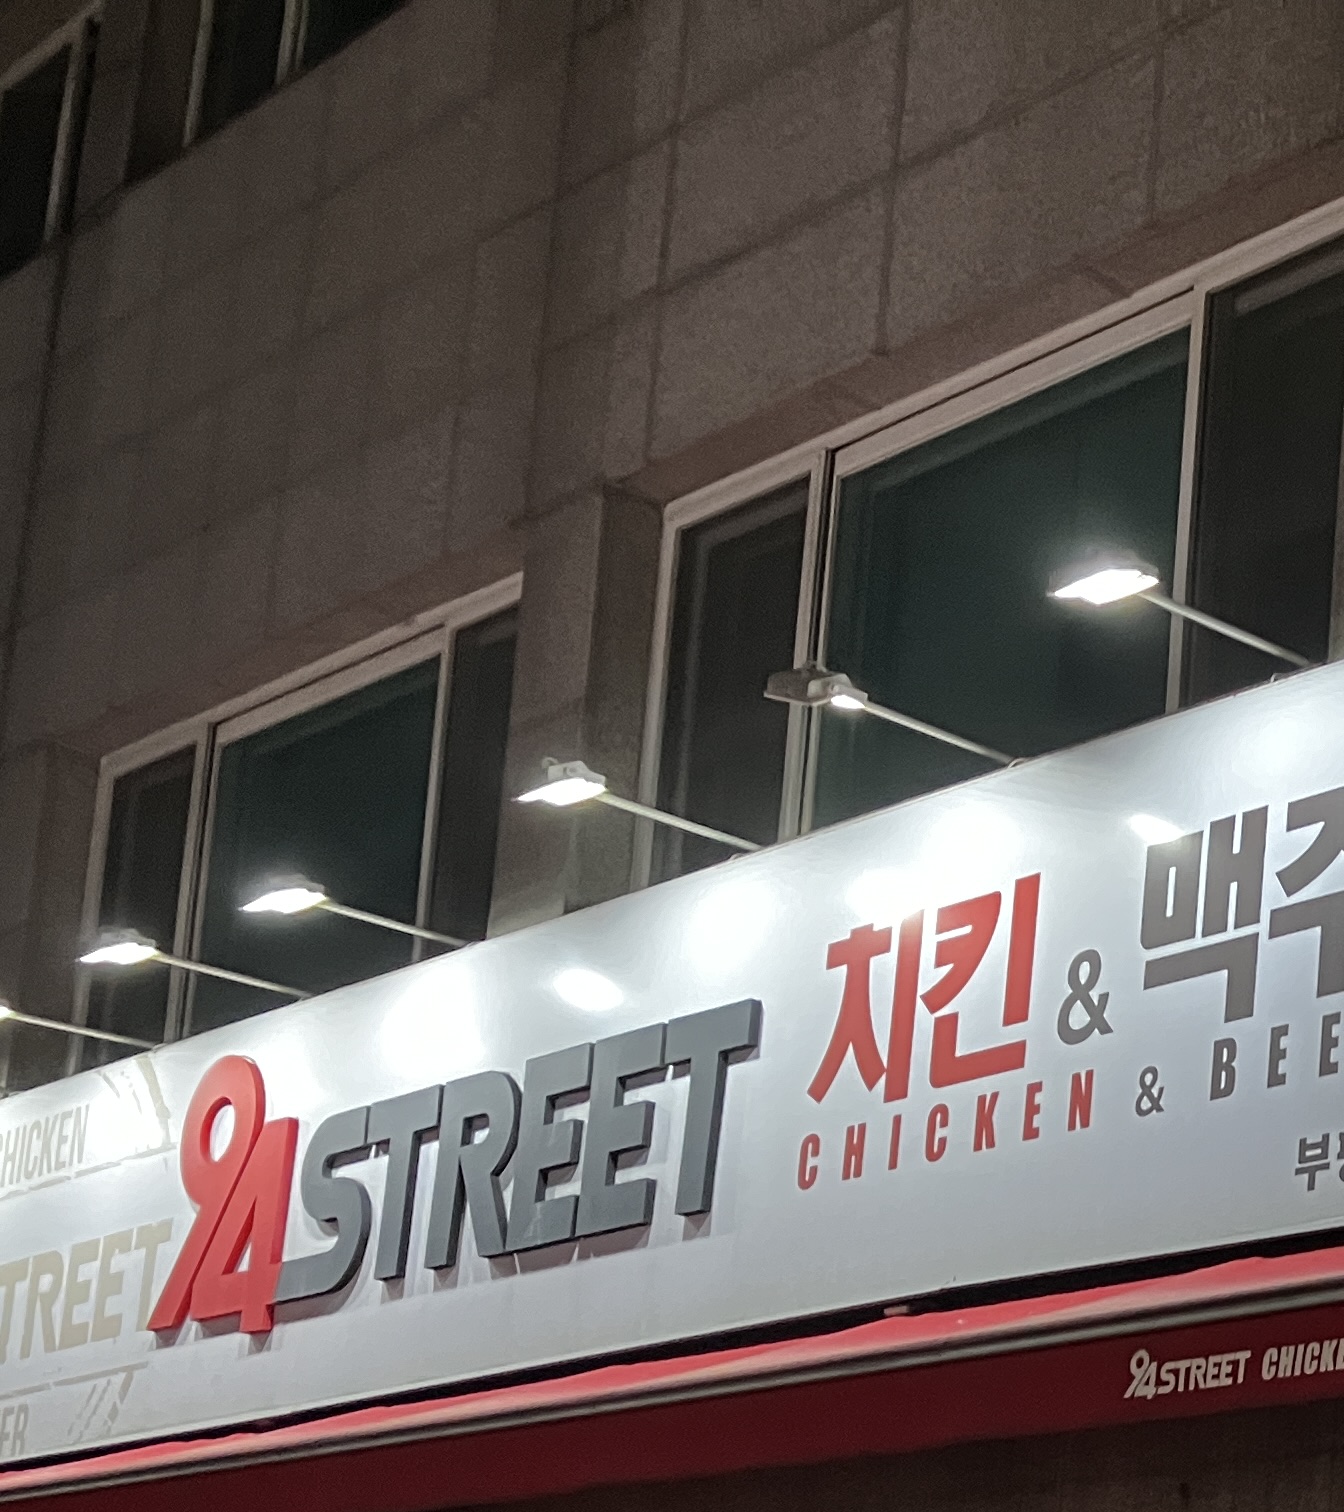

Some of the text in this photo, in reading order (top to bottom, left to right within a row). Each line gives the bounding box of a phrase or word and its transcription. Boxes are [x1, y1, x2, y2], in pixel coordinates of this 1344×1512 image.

[807, 872, 1041, 1104] 치킨
[1057, 950, 1113, 1045] &
[0, 1103, 90, 1188] HICKEN
[147, 998, 761, 1332] 94STREET
[797, 1070, 1094, 1189] CHICKEN
[1135, 1066, 1165, 1117] &
[0, 1218, 173, 1362] TREET
[1124, 1349, 1252, 1399] 94STREET
